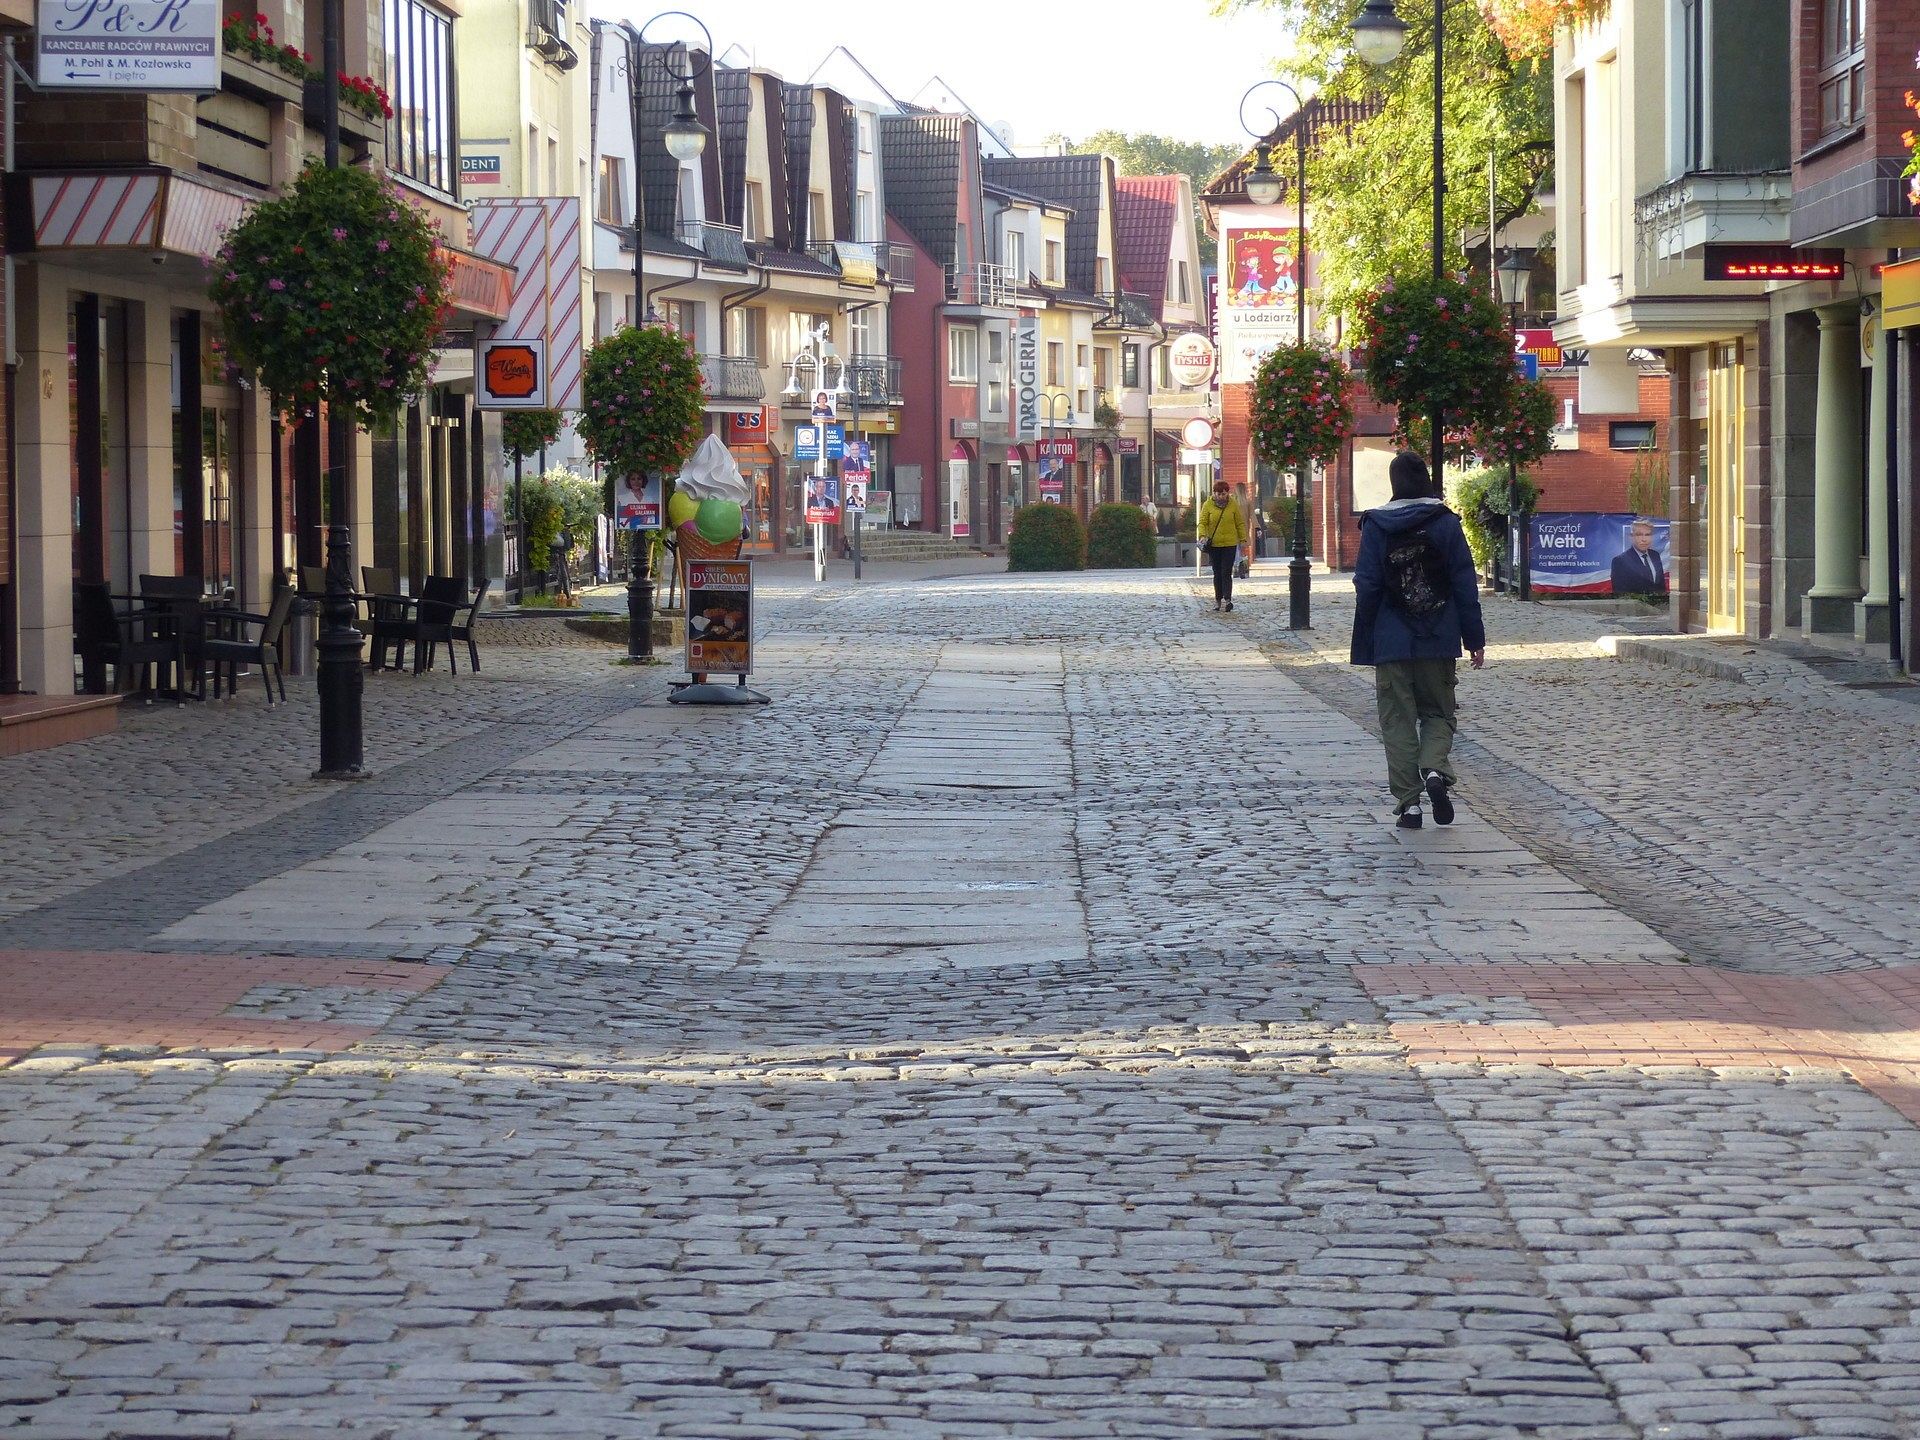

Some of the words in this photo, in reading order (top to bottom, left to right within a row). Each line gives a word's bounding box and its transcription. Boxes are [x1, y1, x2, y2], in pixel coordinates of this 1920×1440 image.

[46, 41, 105, 51] KANCELARIE
[107, 40, 152, 51] RADCÓW
[154, 42, 210, 52] PRAWNYCH
[64, 57, 78, 67] M.
[81, 58, 104, 68] Pohl
[107, 59, 114, 68] &
[118, 59, 131, 68] M.
[134, 59, 192, 69] Kozłowska
[114, 71, 147, 81] piętro
[1233, 315, 1241, 323] u
[1244, 312, 1298, 324] Lodziarzy
[1176, 356, 1209, 365] TYSKIE
[1020, 329, 1036, 431] DROGERIA
[1040, 443, 1073, 455] KANTOR
[1538, 523, 1581, 535] Krzysztof
[1538, 533, 1586, 548] Wetta
[692, 572, 747, 583] DYNIOWY
